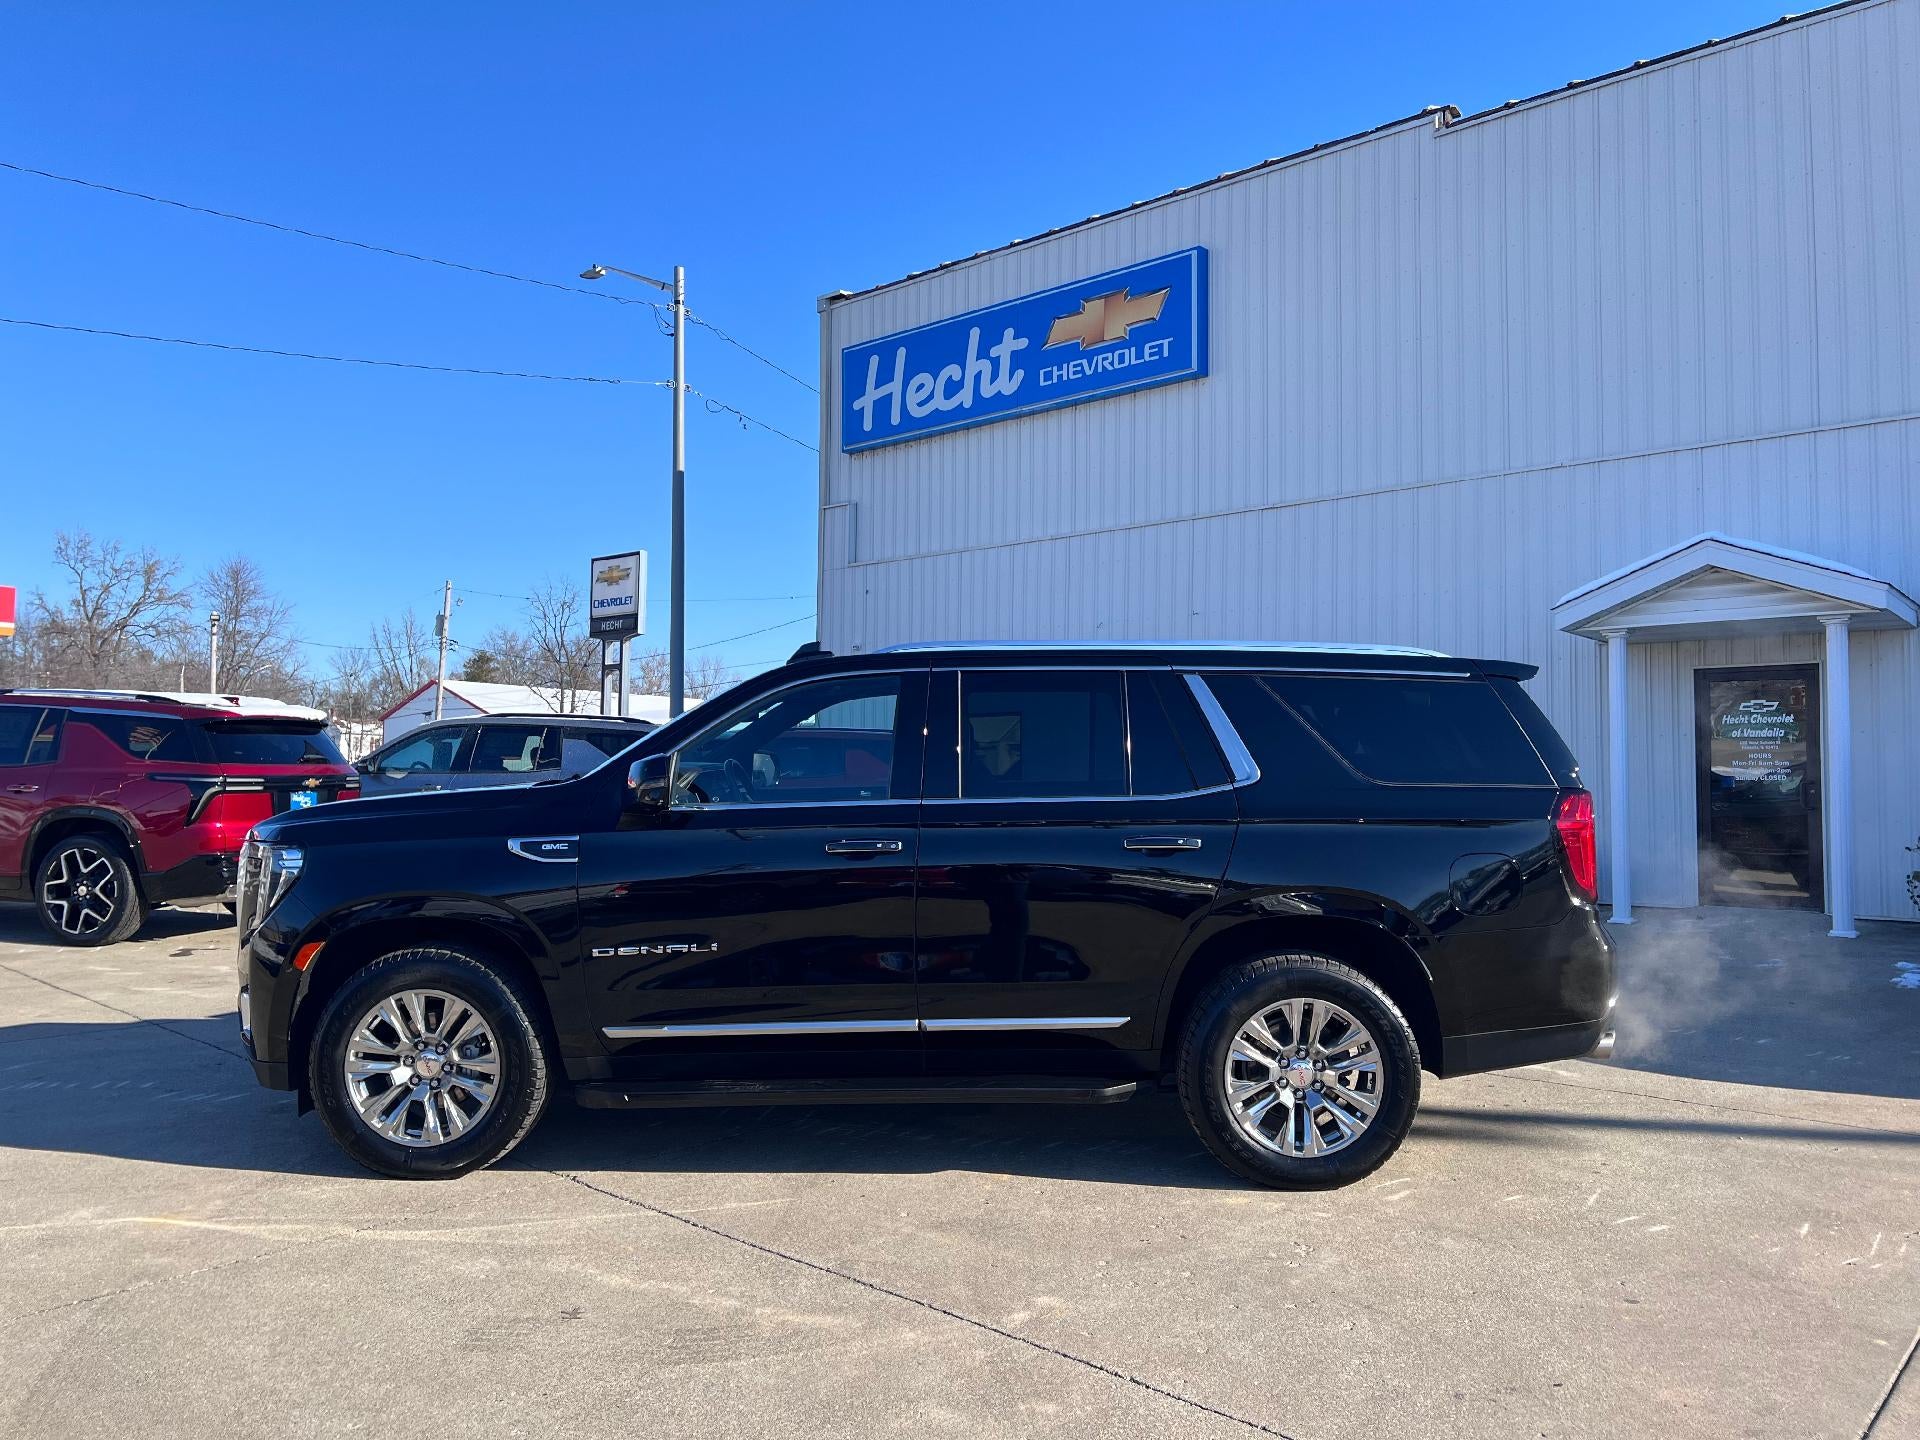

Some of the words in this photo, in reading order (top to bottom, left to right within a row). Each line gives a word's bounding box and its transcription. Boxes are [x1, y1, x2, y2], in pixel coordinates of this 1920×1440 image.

[1039, 337, 1174, 387] CHEVROLET
[853, 326, 1029, 432] Hecht
[593, 596, 633, 609] CHEVROLET
[601, 620, 623, 631] HECHT
[1722, 714, 1748, 724] Hecht
[1750, 714, 1794, 724] Chevrolet
[1732, 728, 1742, 738] of
[1744, 728, 1784, 738] Vandalia
[592, 942, 718, 957] DENALI
